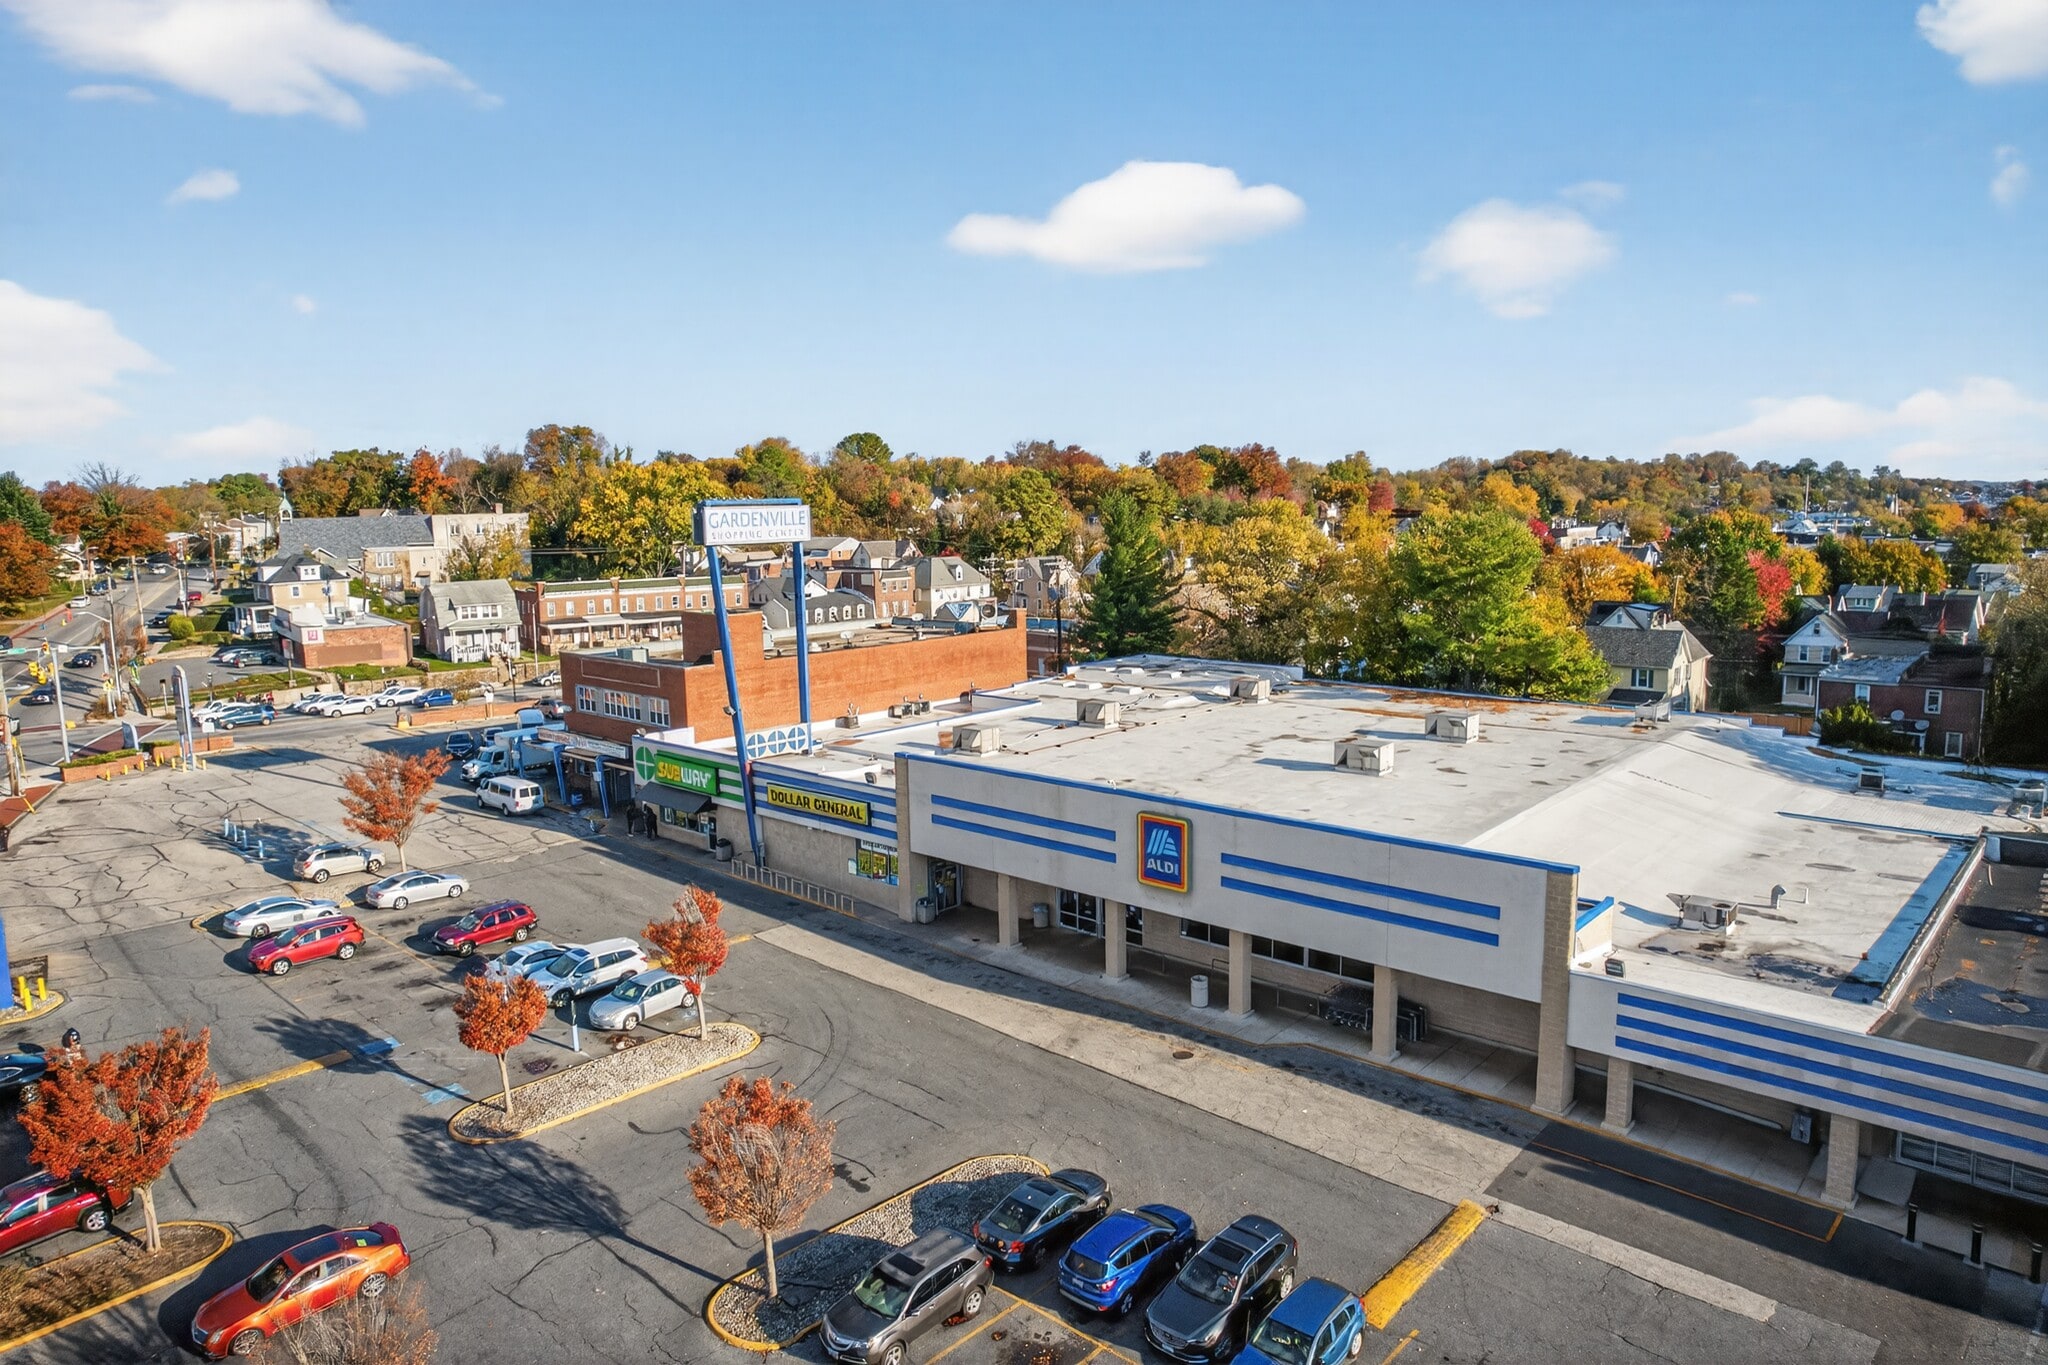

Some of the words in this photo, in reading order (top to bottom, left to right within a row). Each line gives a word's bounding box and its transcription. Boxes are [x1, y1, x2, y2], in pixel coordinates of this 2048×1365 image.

[708, 510, 806, 529] GARDENVILLE
[657, 761, 712, 789] SUBWAY
[770, 789, 811, 810] DOLLAR
[813, 798, 863, 820] GENERAL
[1146, 858, 1179, 876] ALDI
